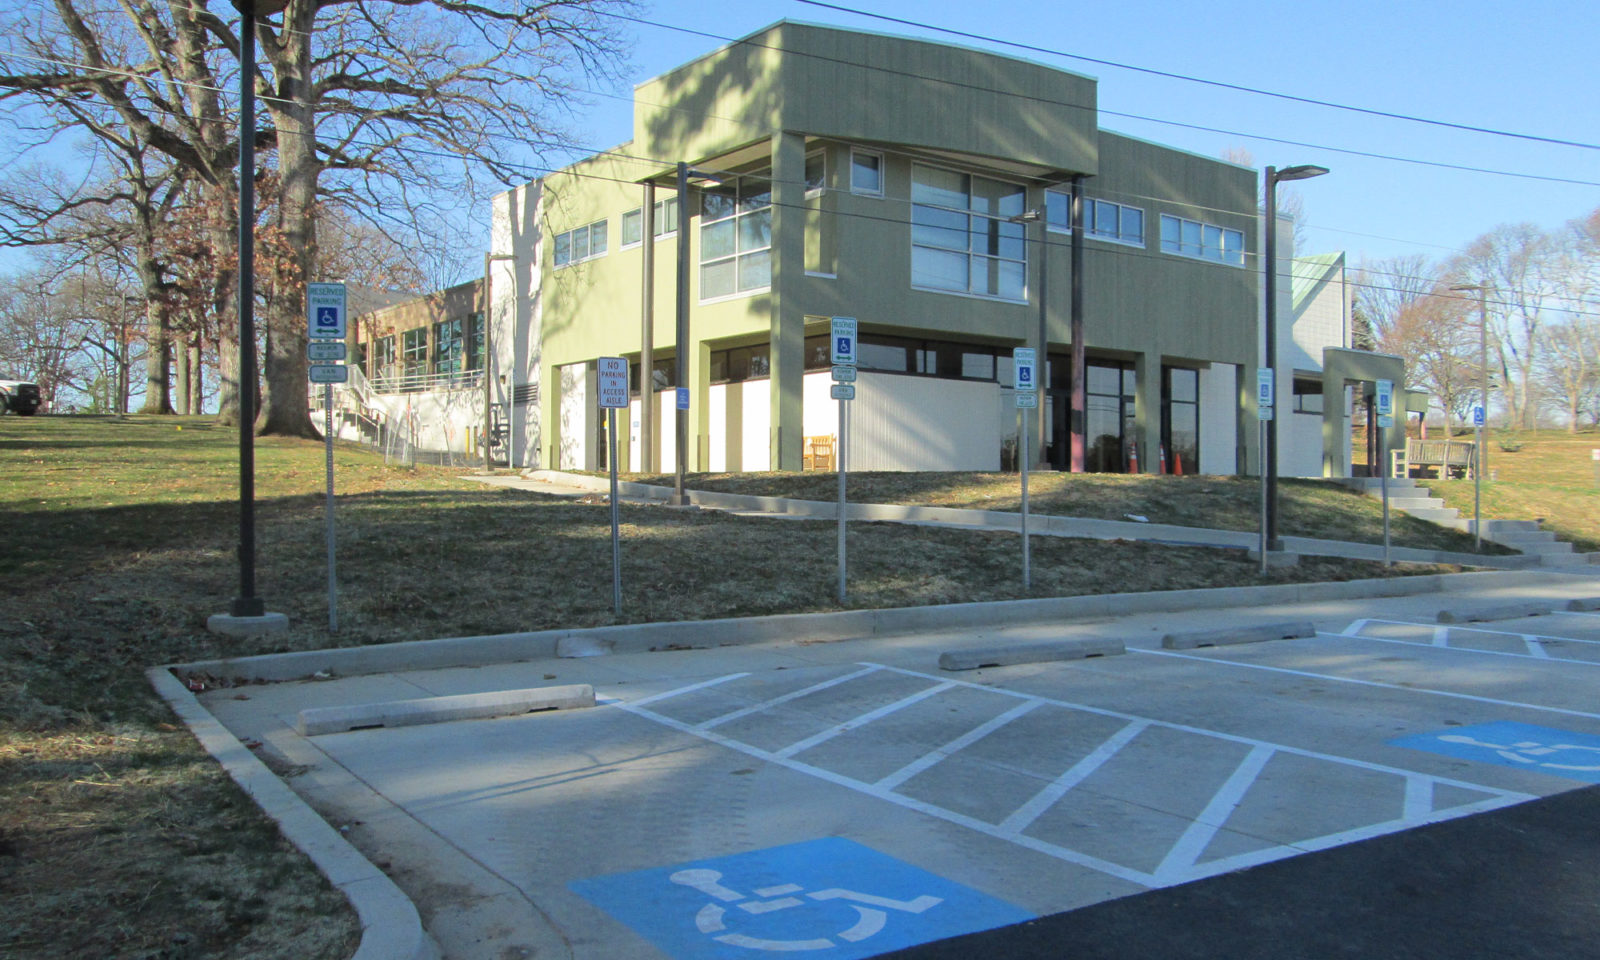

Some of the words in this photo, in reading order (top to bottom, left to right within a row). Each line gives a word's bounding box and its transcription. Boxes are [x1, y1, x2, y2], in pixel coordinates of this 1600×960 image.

[311, 288, 344, 296] RESERVED
[607, 361, 619, 370] NO
[601, 371, 626, 379] PARKING
[603, 388, 625, 396] ACCESS
[606, 397, 622, 405] AISLE
